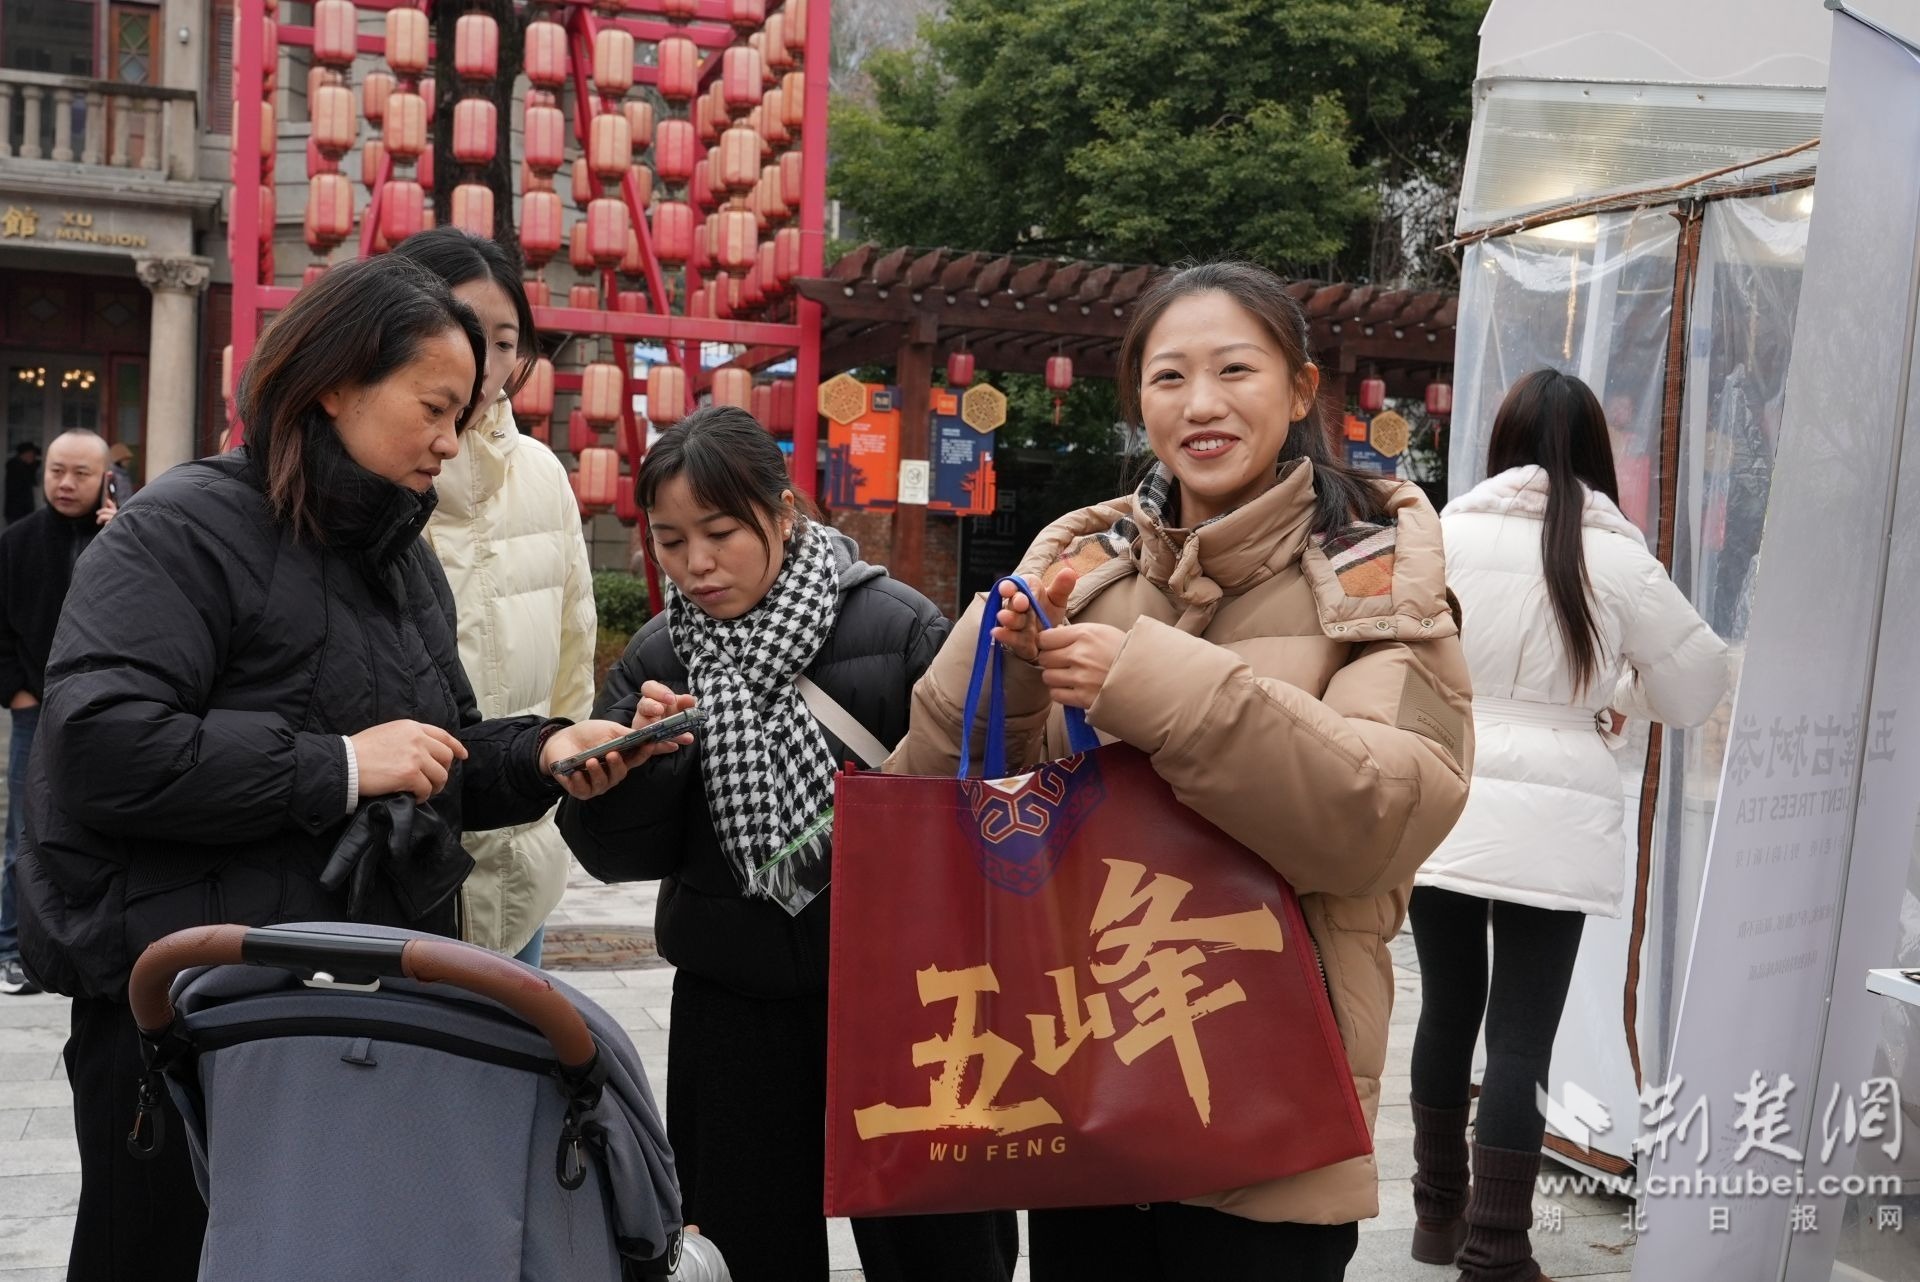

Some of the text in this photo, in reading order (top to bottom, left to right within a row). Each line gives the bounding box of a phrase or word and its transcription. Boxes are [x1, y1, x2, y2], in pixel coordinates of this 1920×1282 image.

[63, 210, 94, 227] XU
[56, 228, 148, 247] MANSION
[854, 858, 1284, 1140] 五峰
[929, 1136, 1066, 1161] WU FENG
